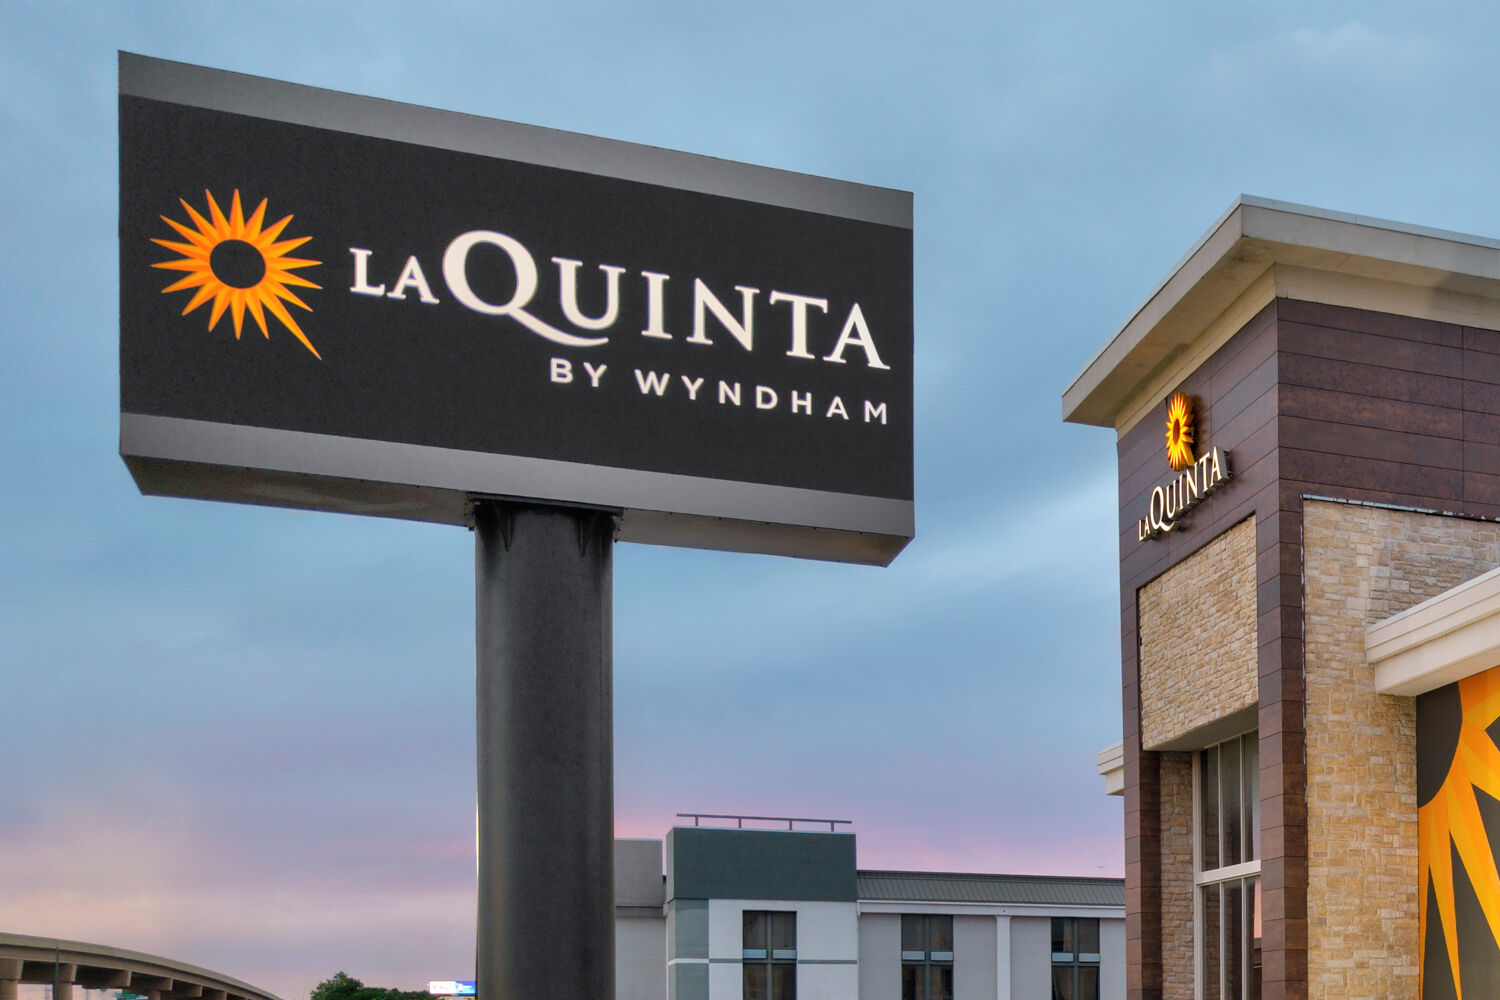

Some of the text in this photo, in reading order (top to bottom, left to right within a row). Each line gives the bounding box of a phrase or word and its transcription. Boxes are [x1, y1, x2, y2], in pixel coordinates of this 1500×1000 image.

[348, 230, 891, 370] LA QUINTA
[550, 357, 888, 425] BY WYNDHAM
[1150, 445, 1223, 532] QUINTA
